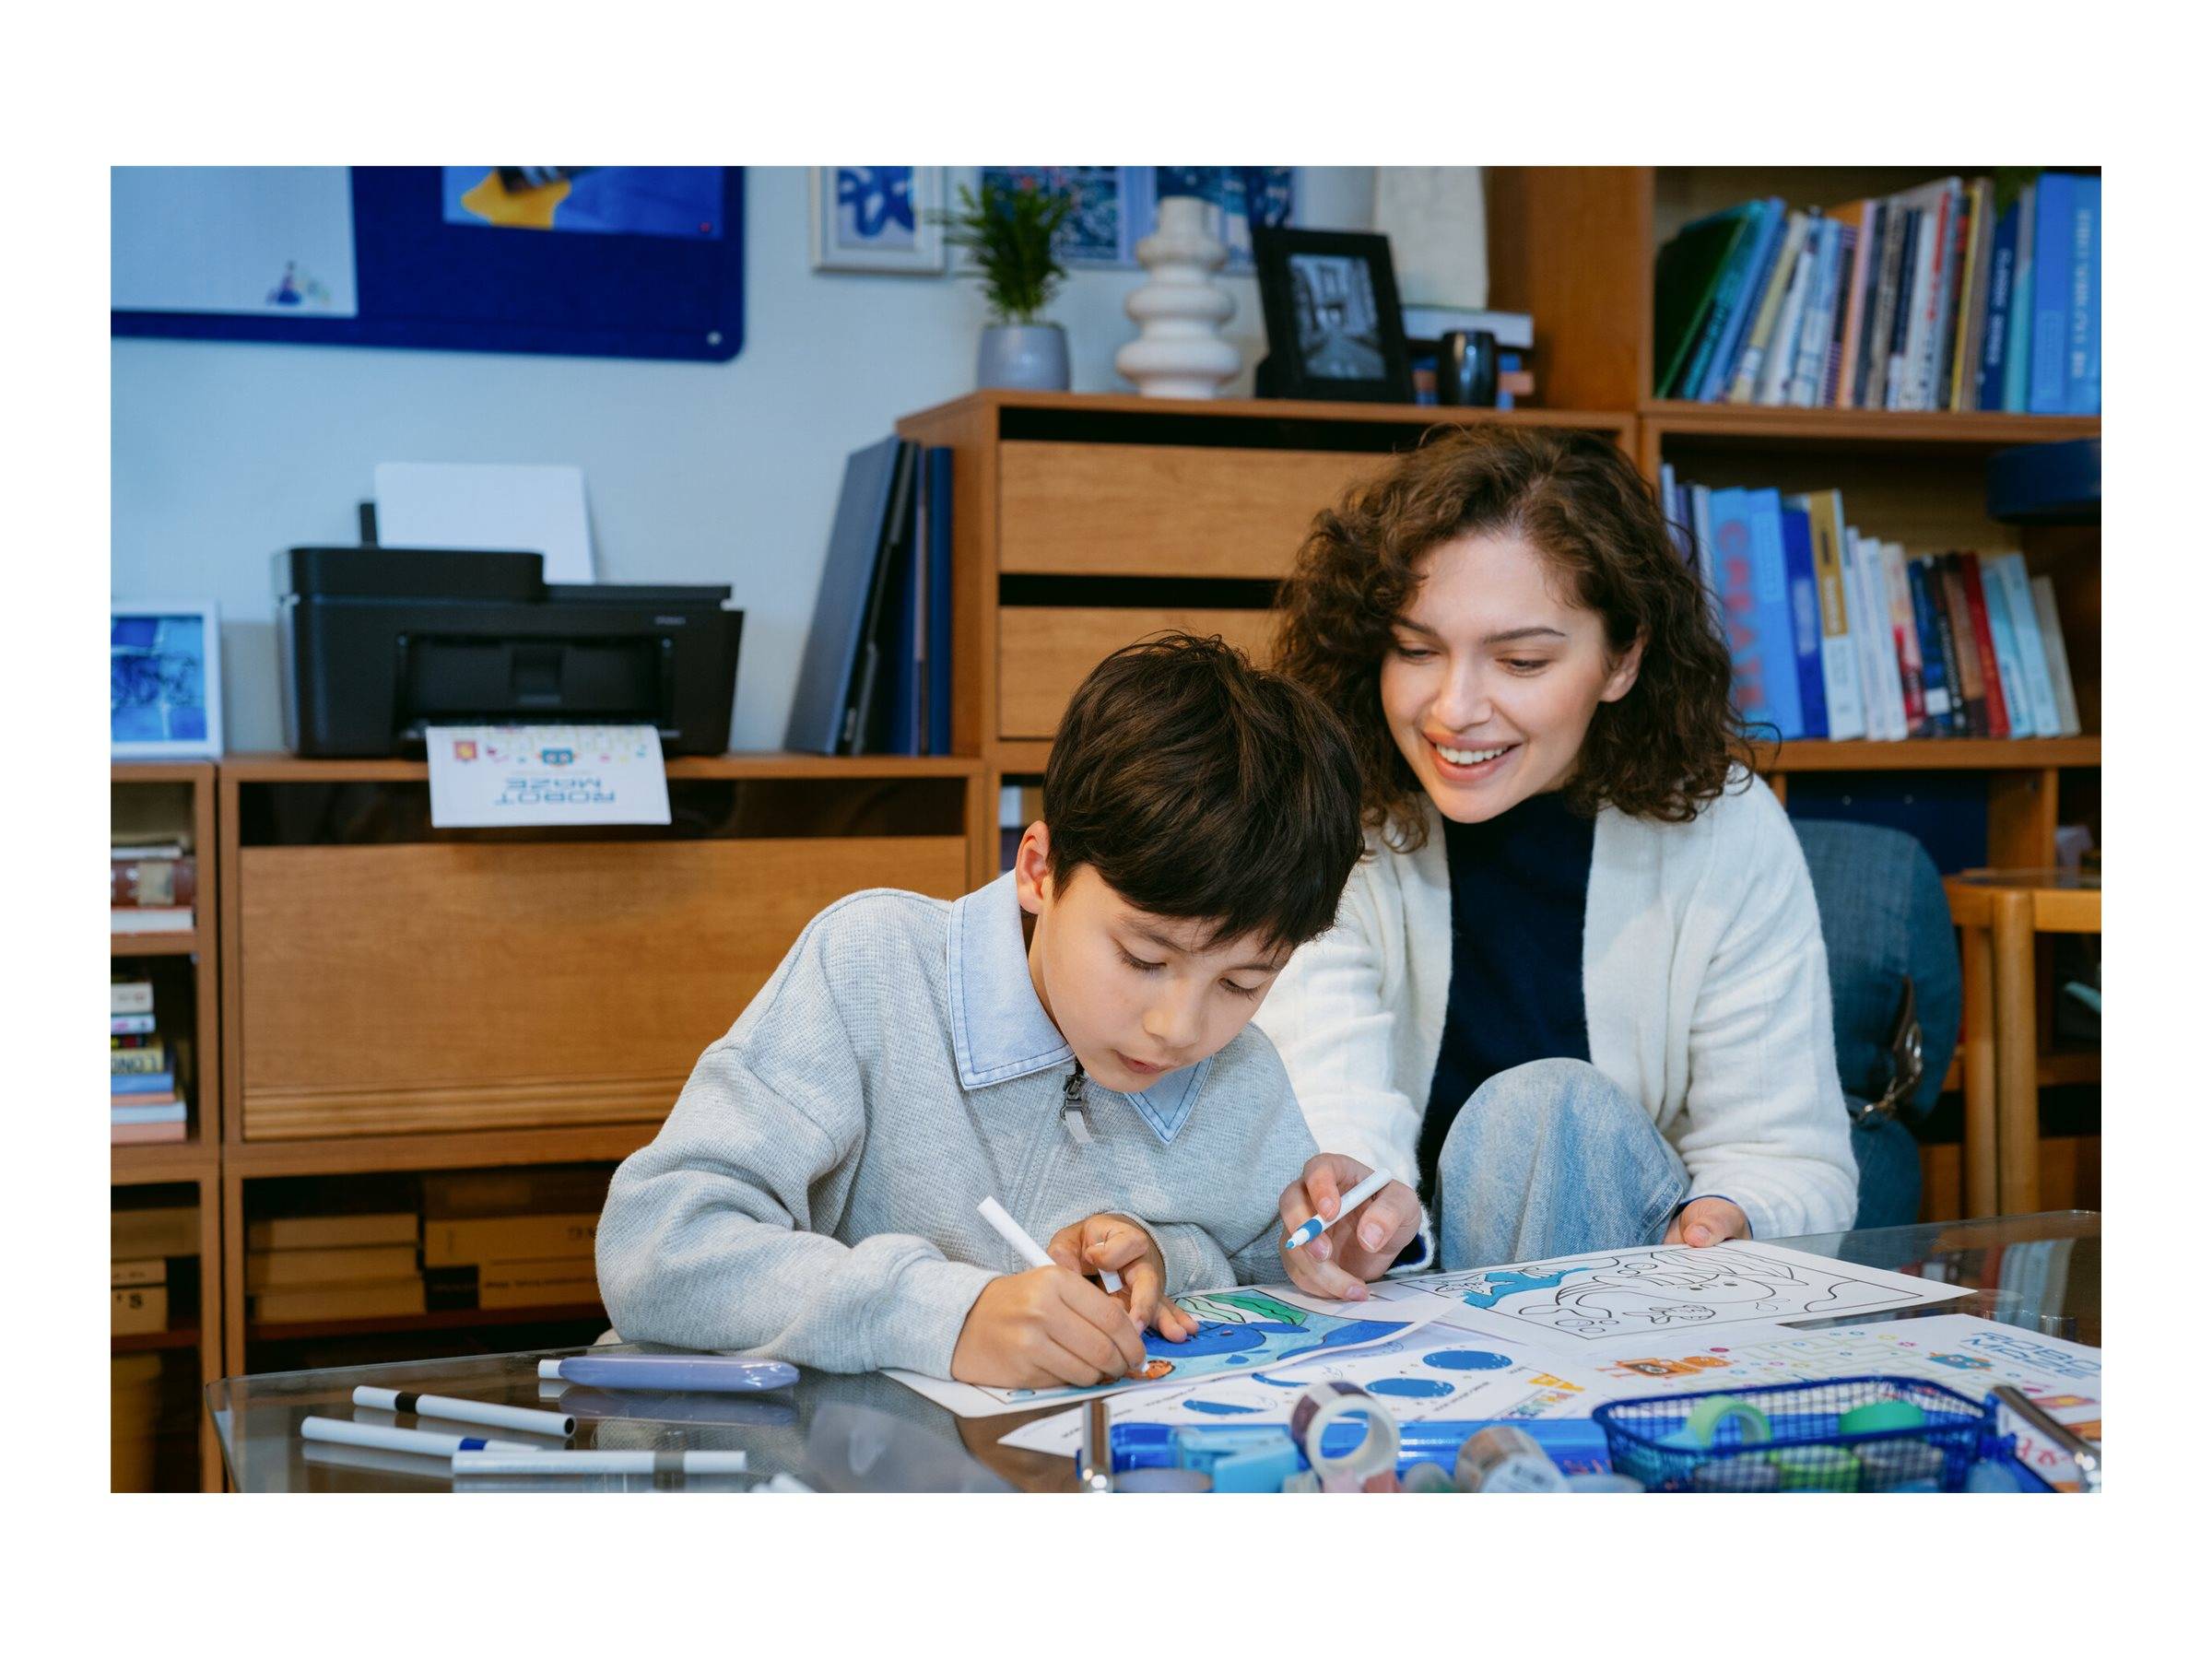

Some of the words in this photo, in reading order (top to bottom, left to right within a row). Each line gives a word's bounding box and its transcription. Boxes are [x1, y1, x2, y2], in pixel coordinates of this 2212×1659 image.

[506, 777, 601, 790] MAZE
[493, 791, 616, 806] ROBOT
[1960, 1338, 2099, 1381] MAZE
